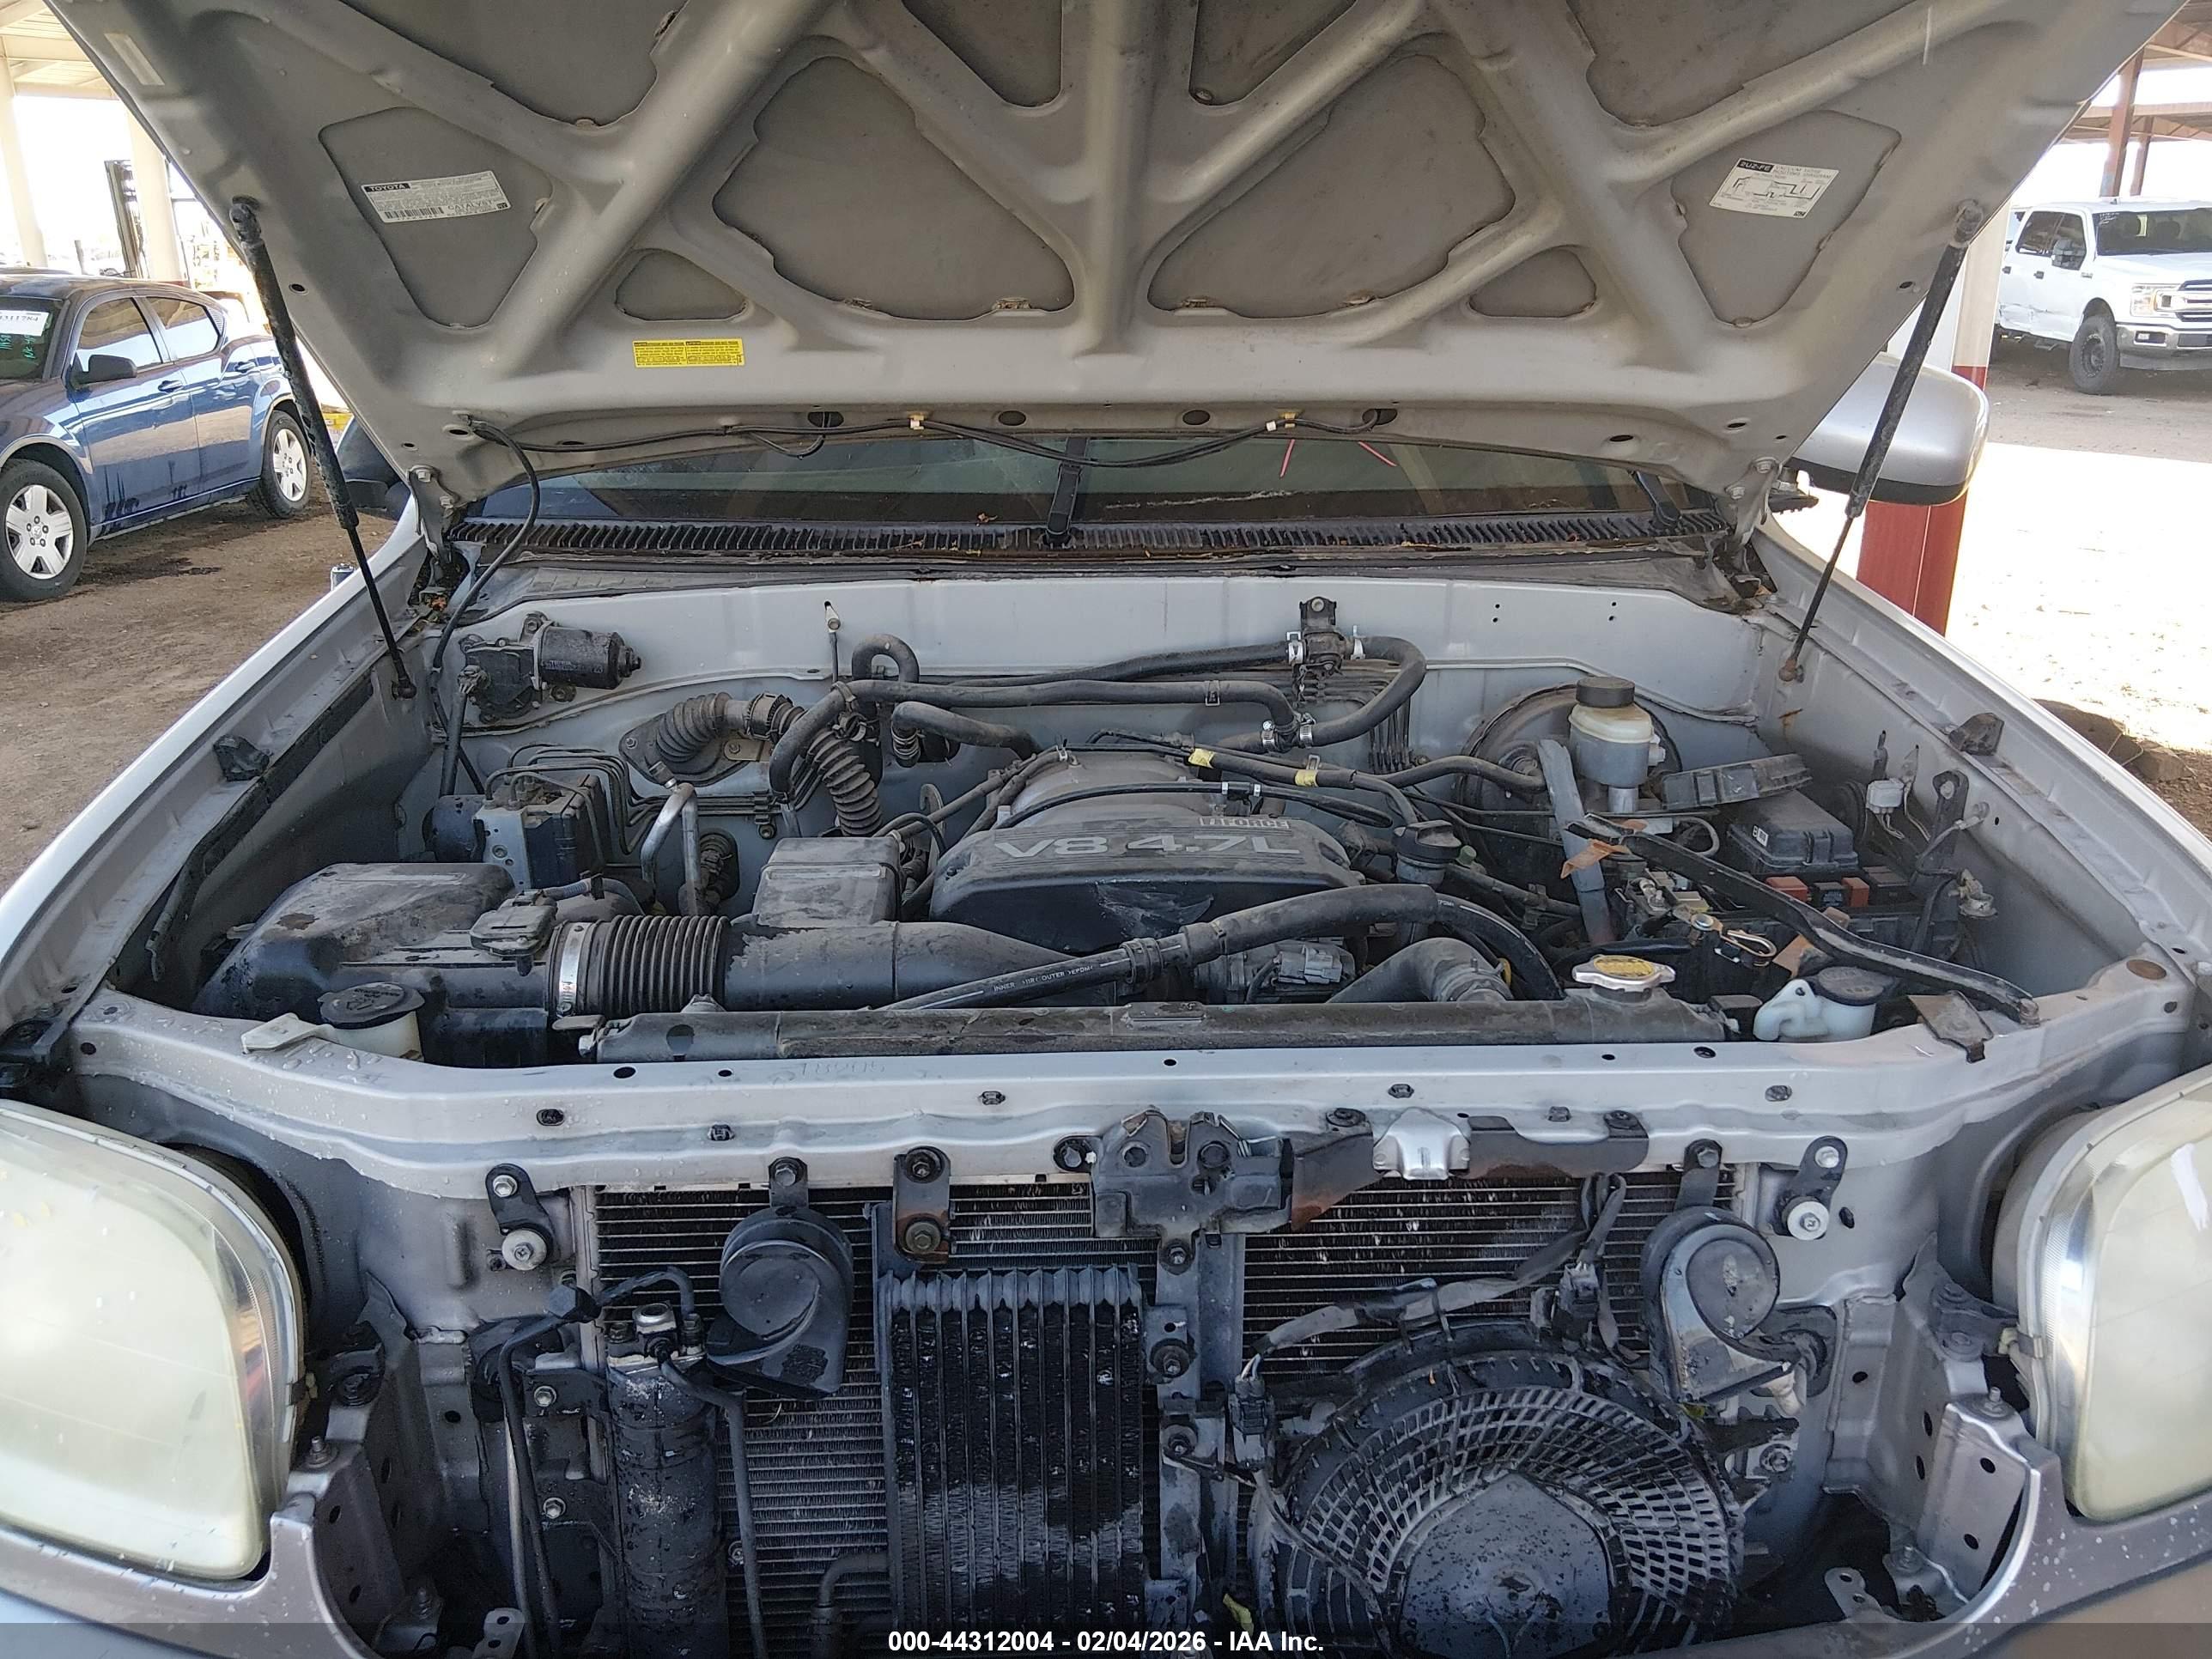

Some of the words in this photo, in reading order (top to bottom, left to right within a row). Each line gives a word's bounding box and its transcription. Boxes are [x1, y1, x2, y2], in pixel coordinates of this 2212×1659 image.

[370, 183, 406, 192] TOYOTA
[994, 836, 1108, 858] V8
[1127, 835, 1301, 854] 4.7L
[994, 981, 1016, 992] INNER
[1041, 971, 1066, 981] OUTER
